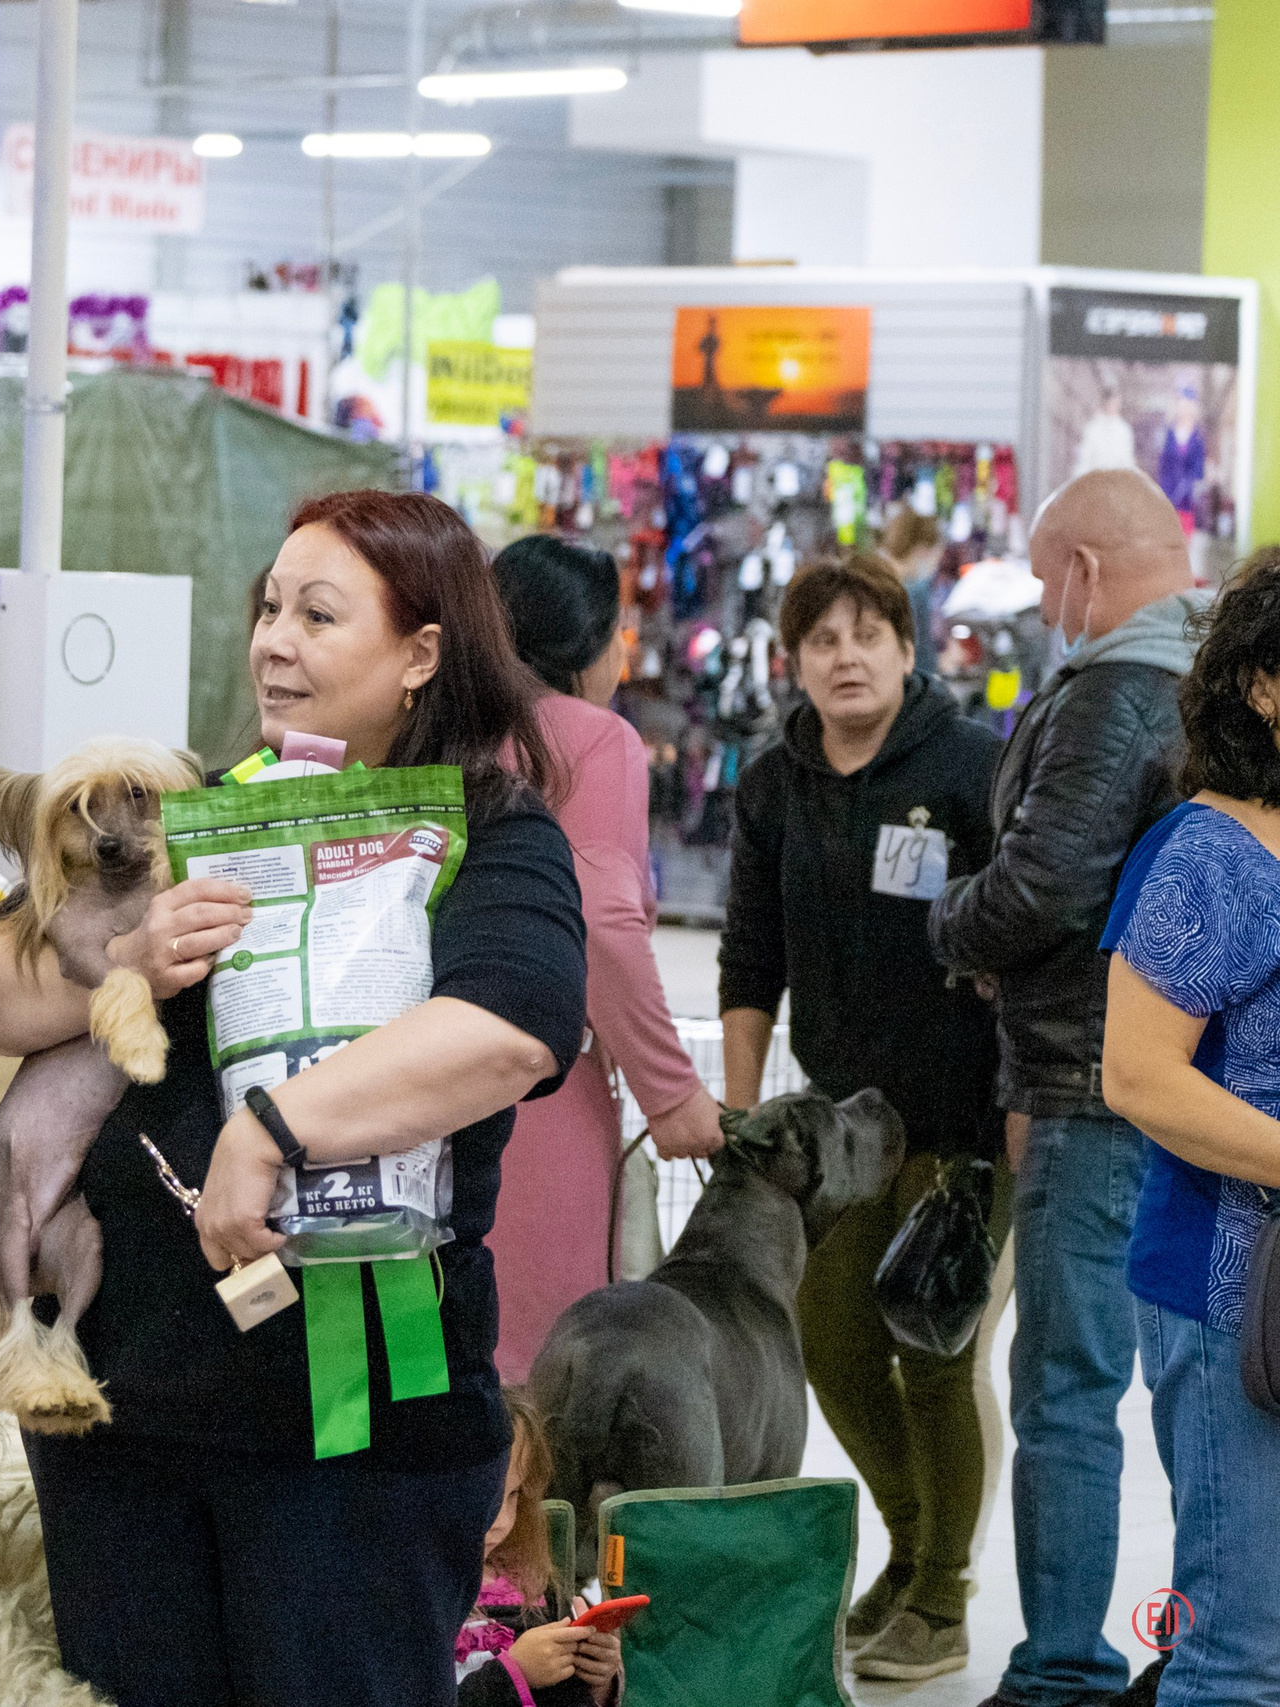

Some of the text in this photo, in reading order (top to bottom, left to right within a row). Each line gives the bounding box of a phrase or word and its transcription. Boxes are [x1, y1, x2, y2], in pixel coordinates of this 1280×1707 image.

[247, 823, 263, 831] 100%
[317, 840, 385, 861] ADULT DOG
[884, 826, 929, 888] 49
[317, 858, 354, 870] STANDART
[318, 870, 352, 881] Мясной
[323, 1171, 354, 1199] 2
[307, 1202, 331, 1214] ВЕС
[335, 1197, 376, 1211] НЕТТО
